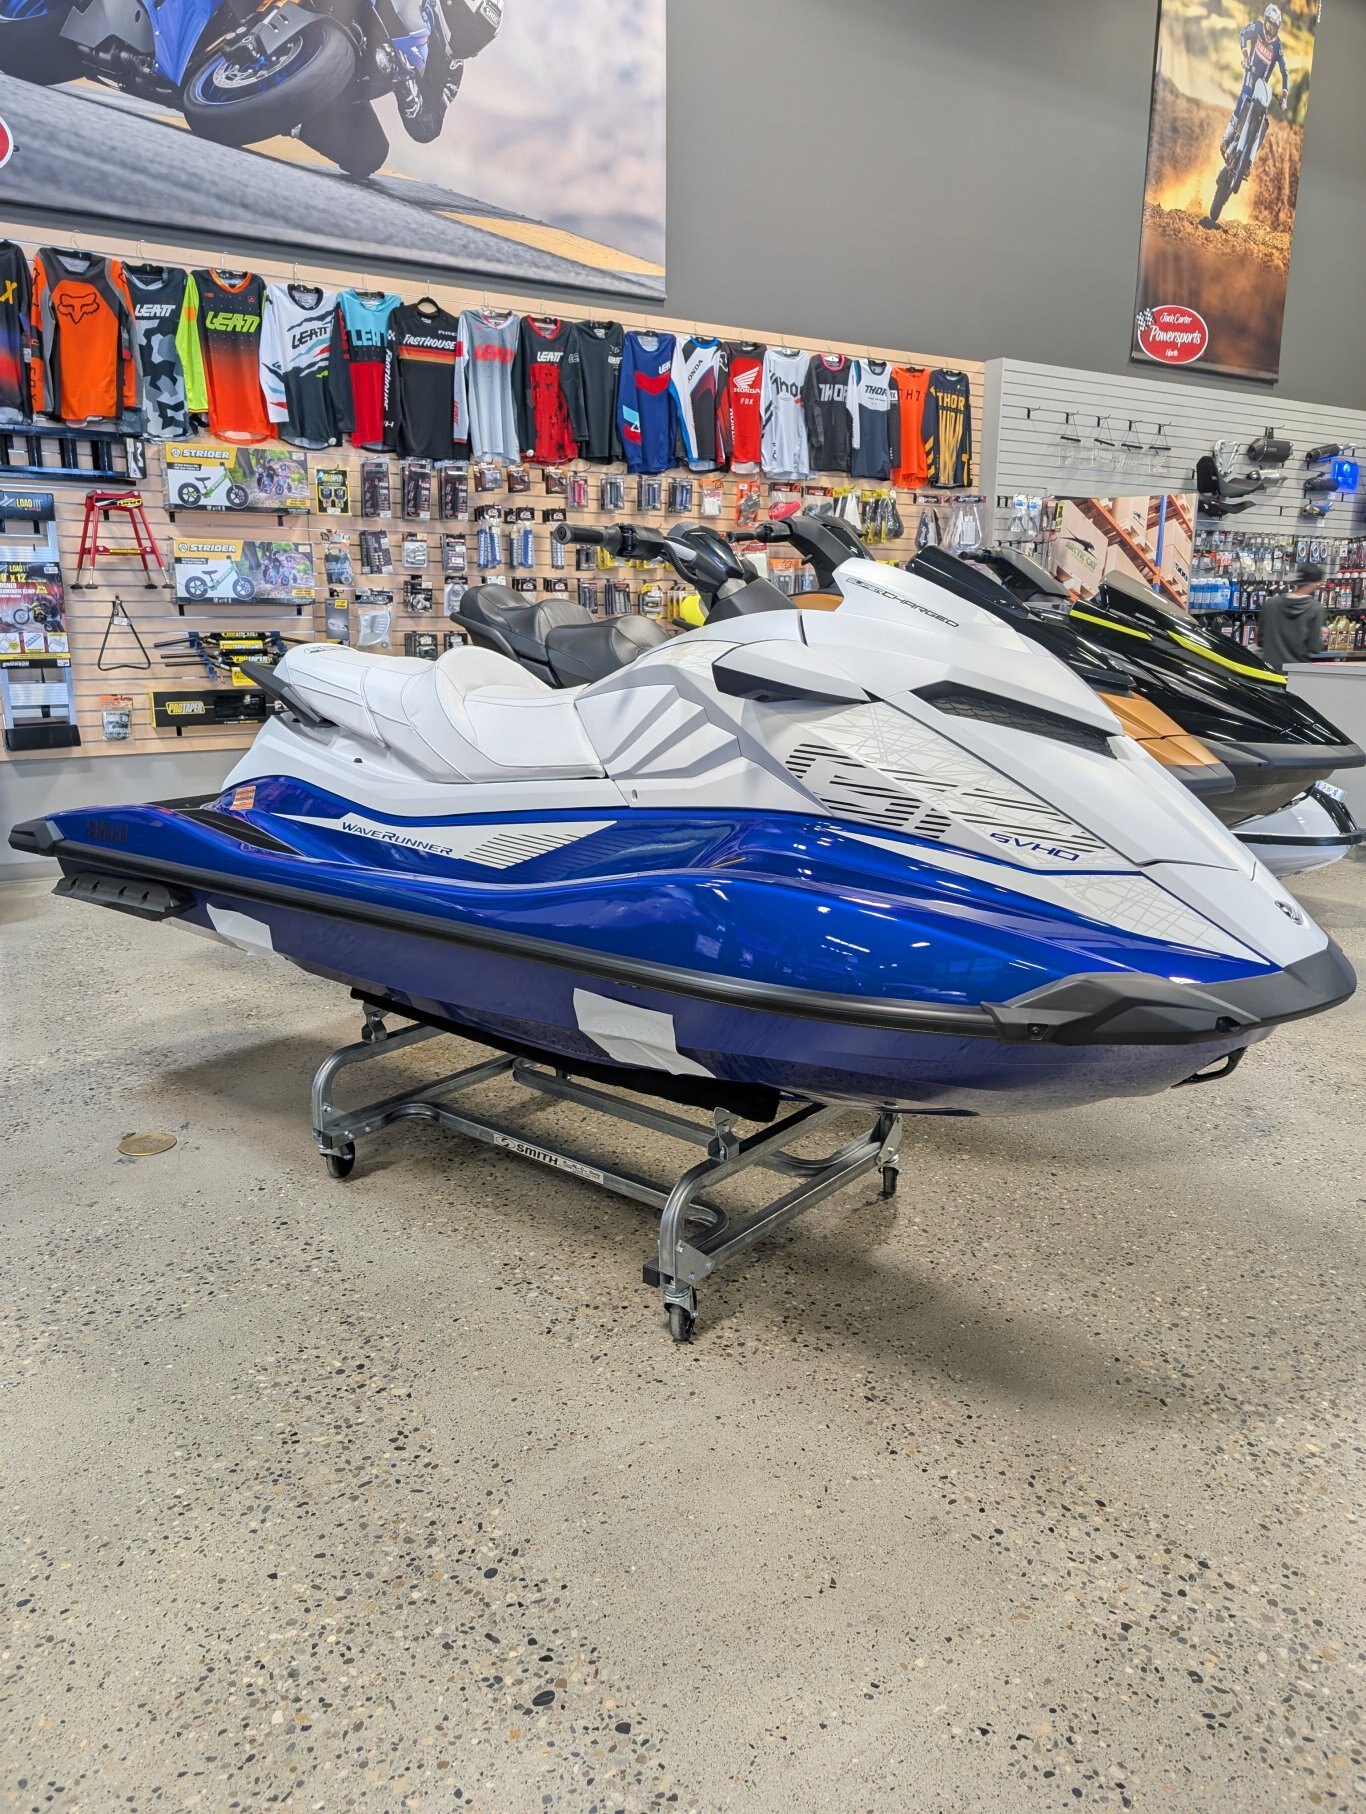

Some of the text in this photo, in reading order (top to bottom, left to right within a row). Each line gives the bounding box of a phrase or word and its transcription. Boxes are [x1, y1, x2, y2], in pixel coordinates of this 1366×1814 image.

[135, 303, 176, 317] LEATT
[1160, 312, 1192, 324] Jack Carter
[205, 311, 261, 334] LEATT
[291, 325, 329, 350] LEATT
[351, 329, 388, 347] LEAT
[403, 333, 456, 350] FASTHOUSE
[1149, 325, 1202, 347] Powersports
[687, 359, 704, 383] ONDA
[740, 397, 755, 405] FOX
[936, 391, 966, 411] THOR
[182, 448, 231, 459] STRIDER
[16, 498, 33, 508] LOAD
[188, 543, 237, 553] STRIDER
[1065, 541, 1098, 570] ARCTIC CAT
[989, 832, 1081, 862] SVHO
